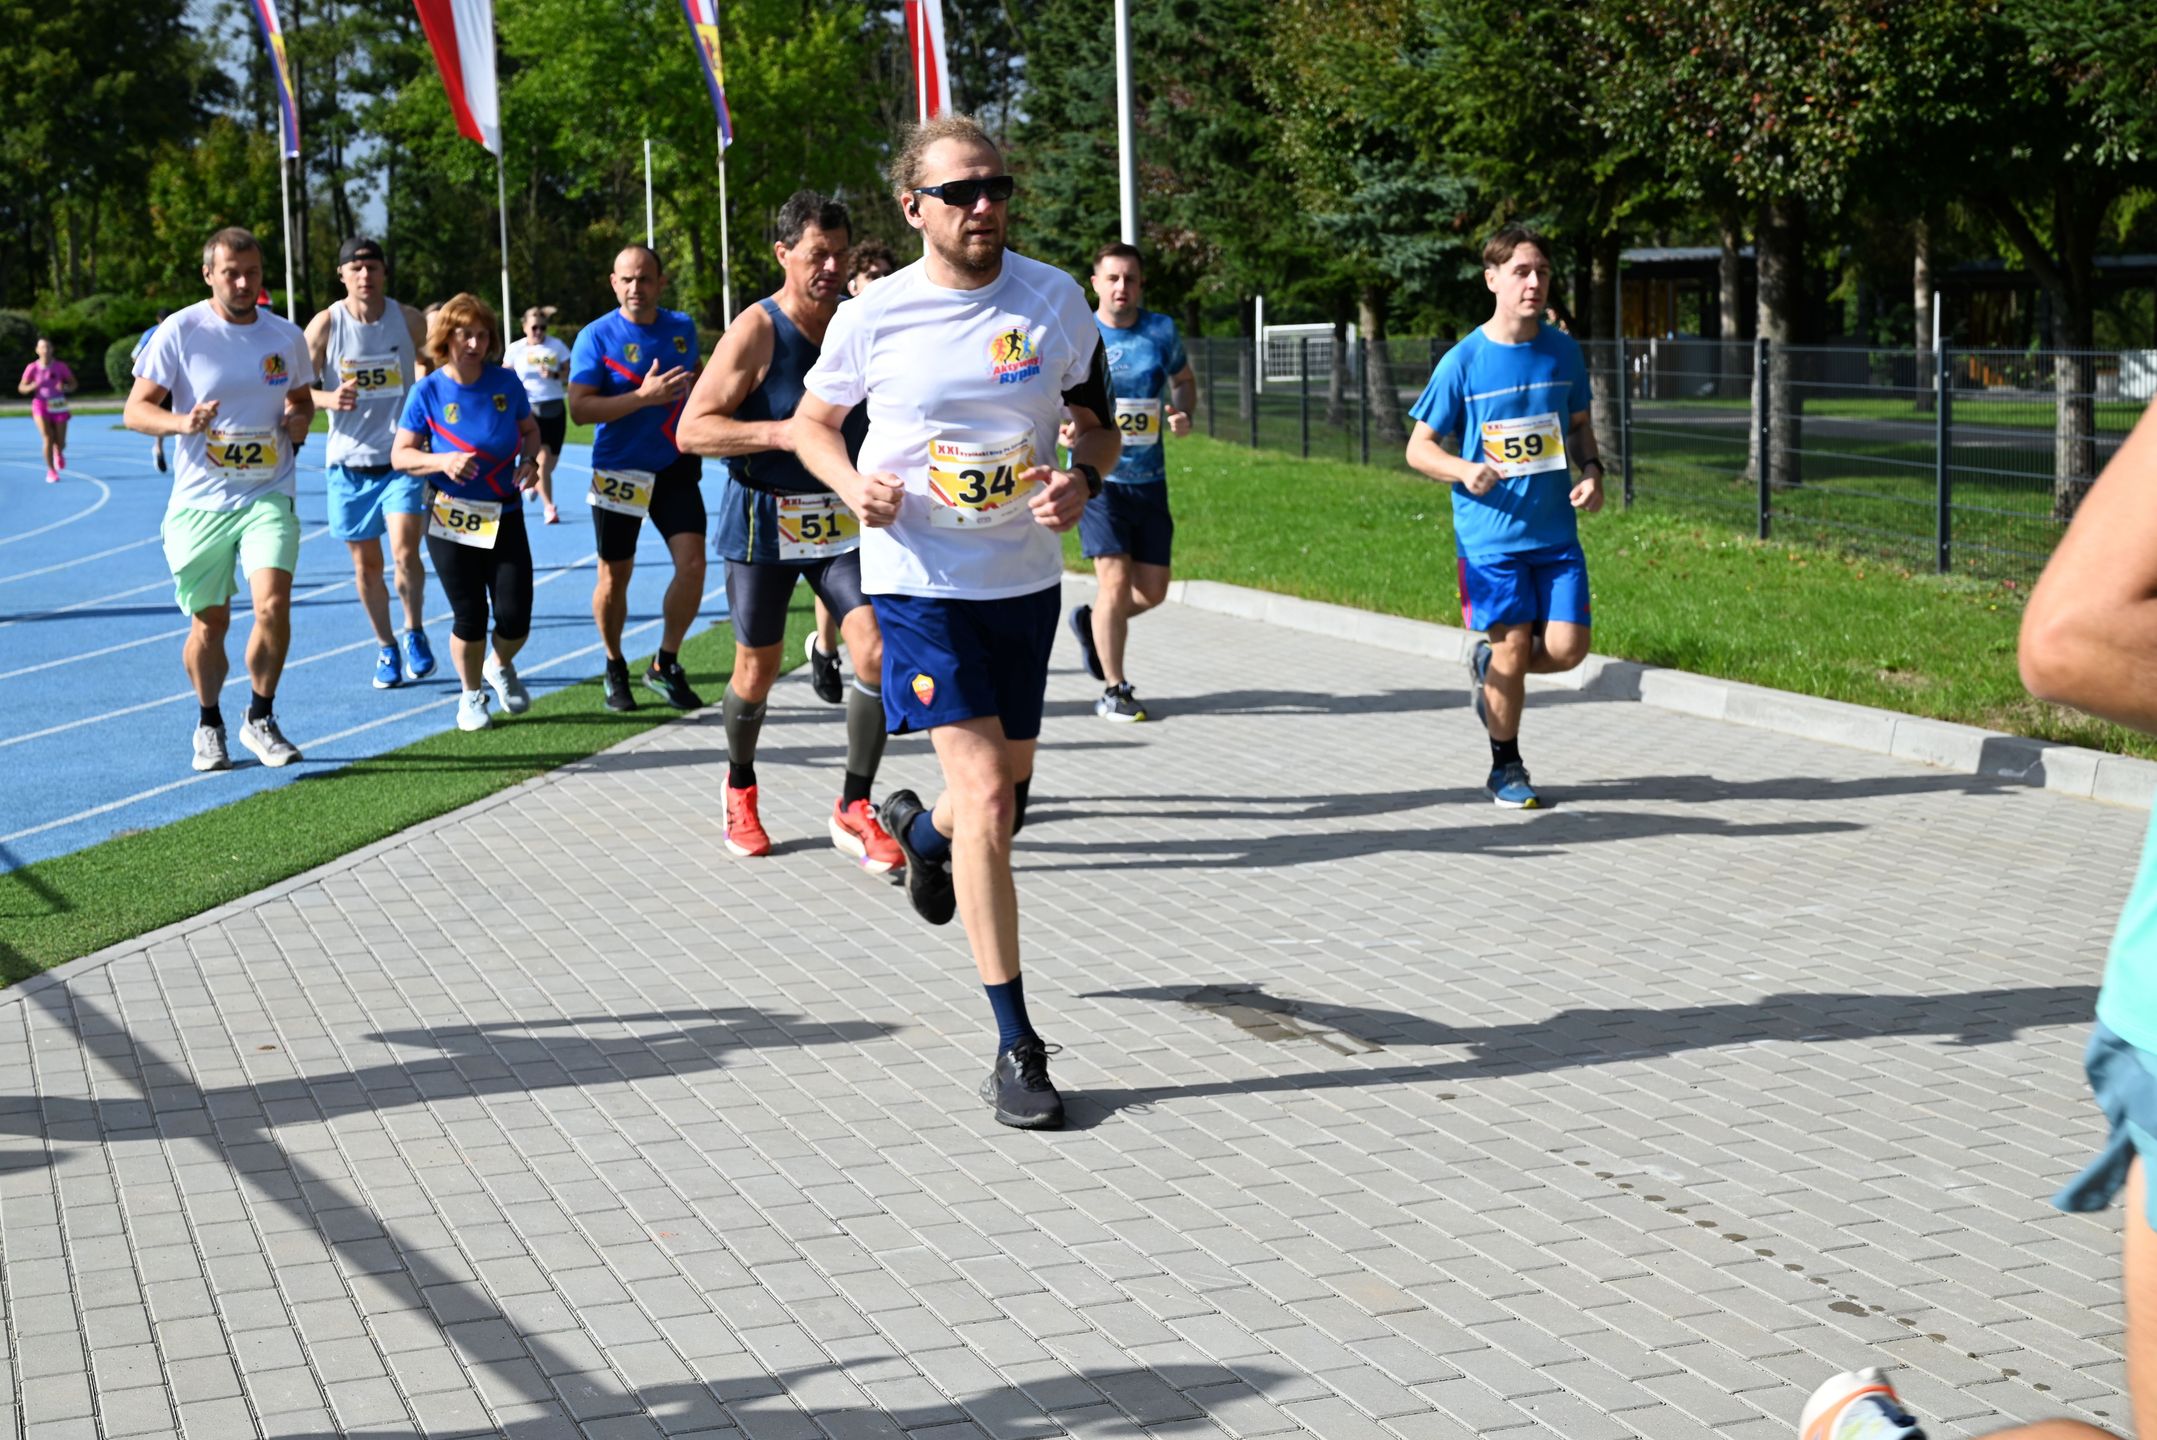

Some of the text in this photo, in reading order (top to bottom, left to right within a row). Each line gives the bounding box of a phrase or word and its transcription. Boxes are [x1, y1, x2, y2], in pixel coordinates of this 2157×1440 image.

[356, 368, 387, 387] 55
[1000, 365, 1040, 384] Rypin
[1119, 412, 1149, 431] 29
[224, 442, 263, 464] 42
[938, 444, 959, 456] XXI
[1504, 433, 1543, 459] 59
[603, 477, 635, 500] 25
[959, 465, 1015, 504] 34
[448, 508, 482, 531] 58
[801, 510, 841, 539] 51
